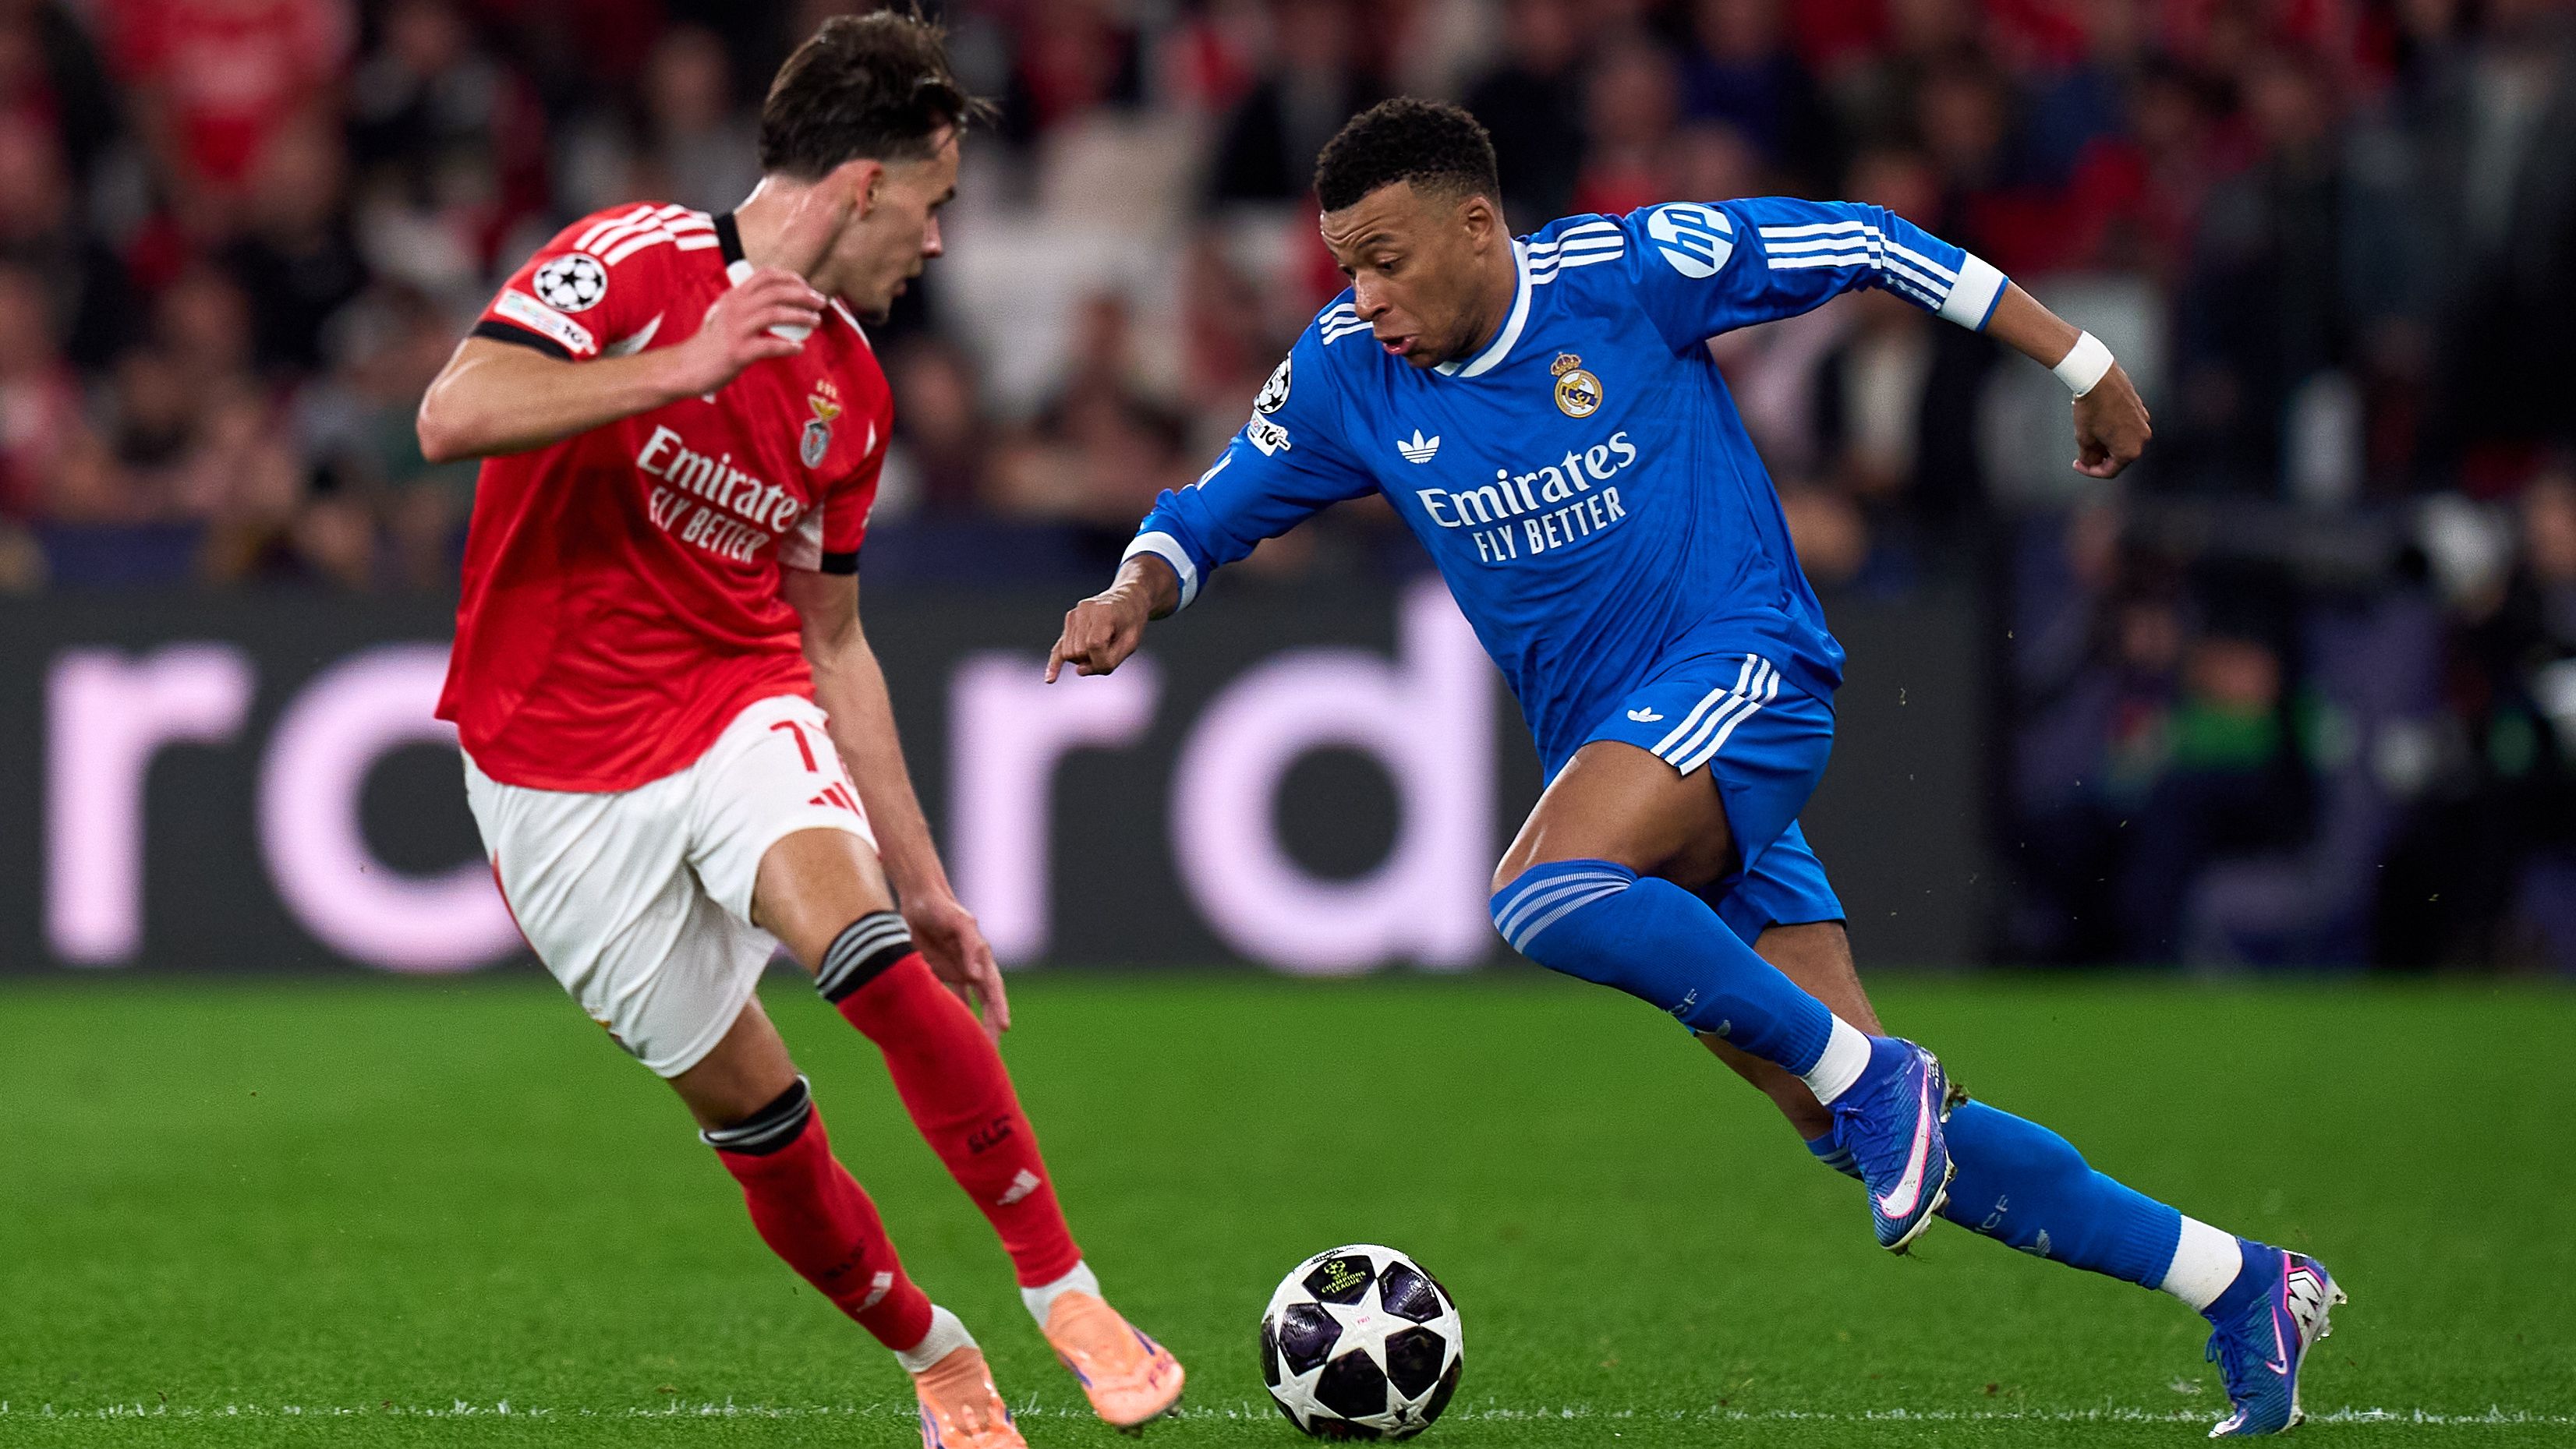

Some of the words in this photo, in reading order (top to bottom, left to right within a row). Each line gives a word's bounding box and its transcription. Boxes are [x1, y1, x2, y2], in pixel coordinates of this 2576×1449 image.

[1650, 209, 1733, 269] hp
[637, 425, 809, 533] Emirate
[1416, 431, 1637, 528] Emirates
[649, 486, 692, 532] FLY
[681, 506, 771, 565] BETTER
[1472, 525, 1517, 563] FLY
[1523, 486, 1626, 555] BETTER
[1976, 1194, 2008, 1232] CF
[1322, 1271, 1366, 1293] CHAMPIONS
[1331, 1276, 1362, 1294] LEAGUE
